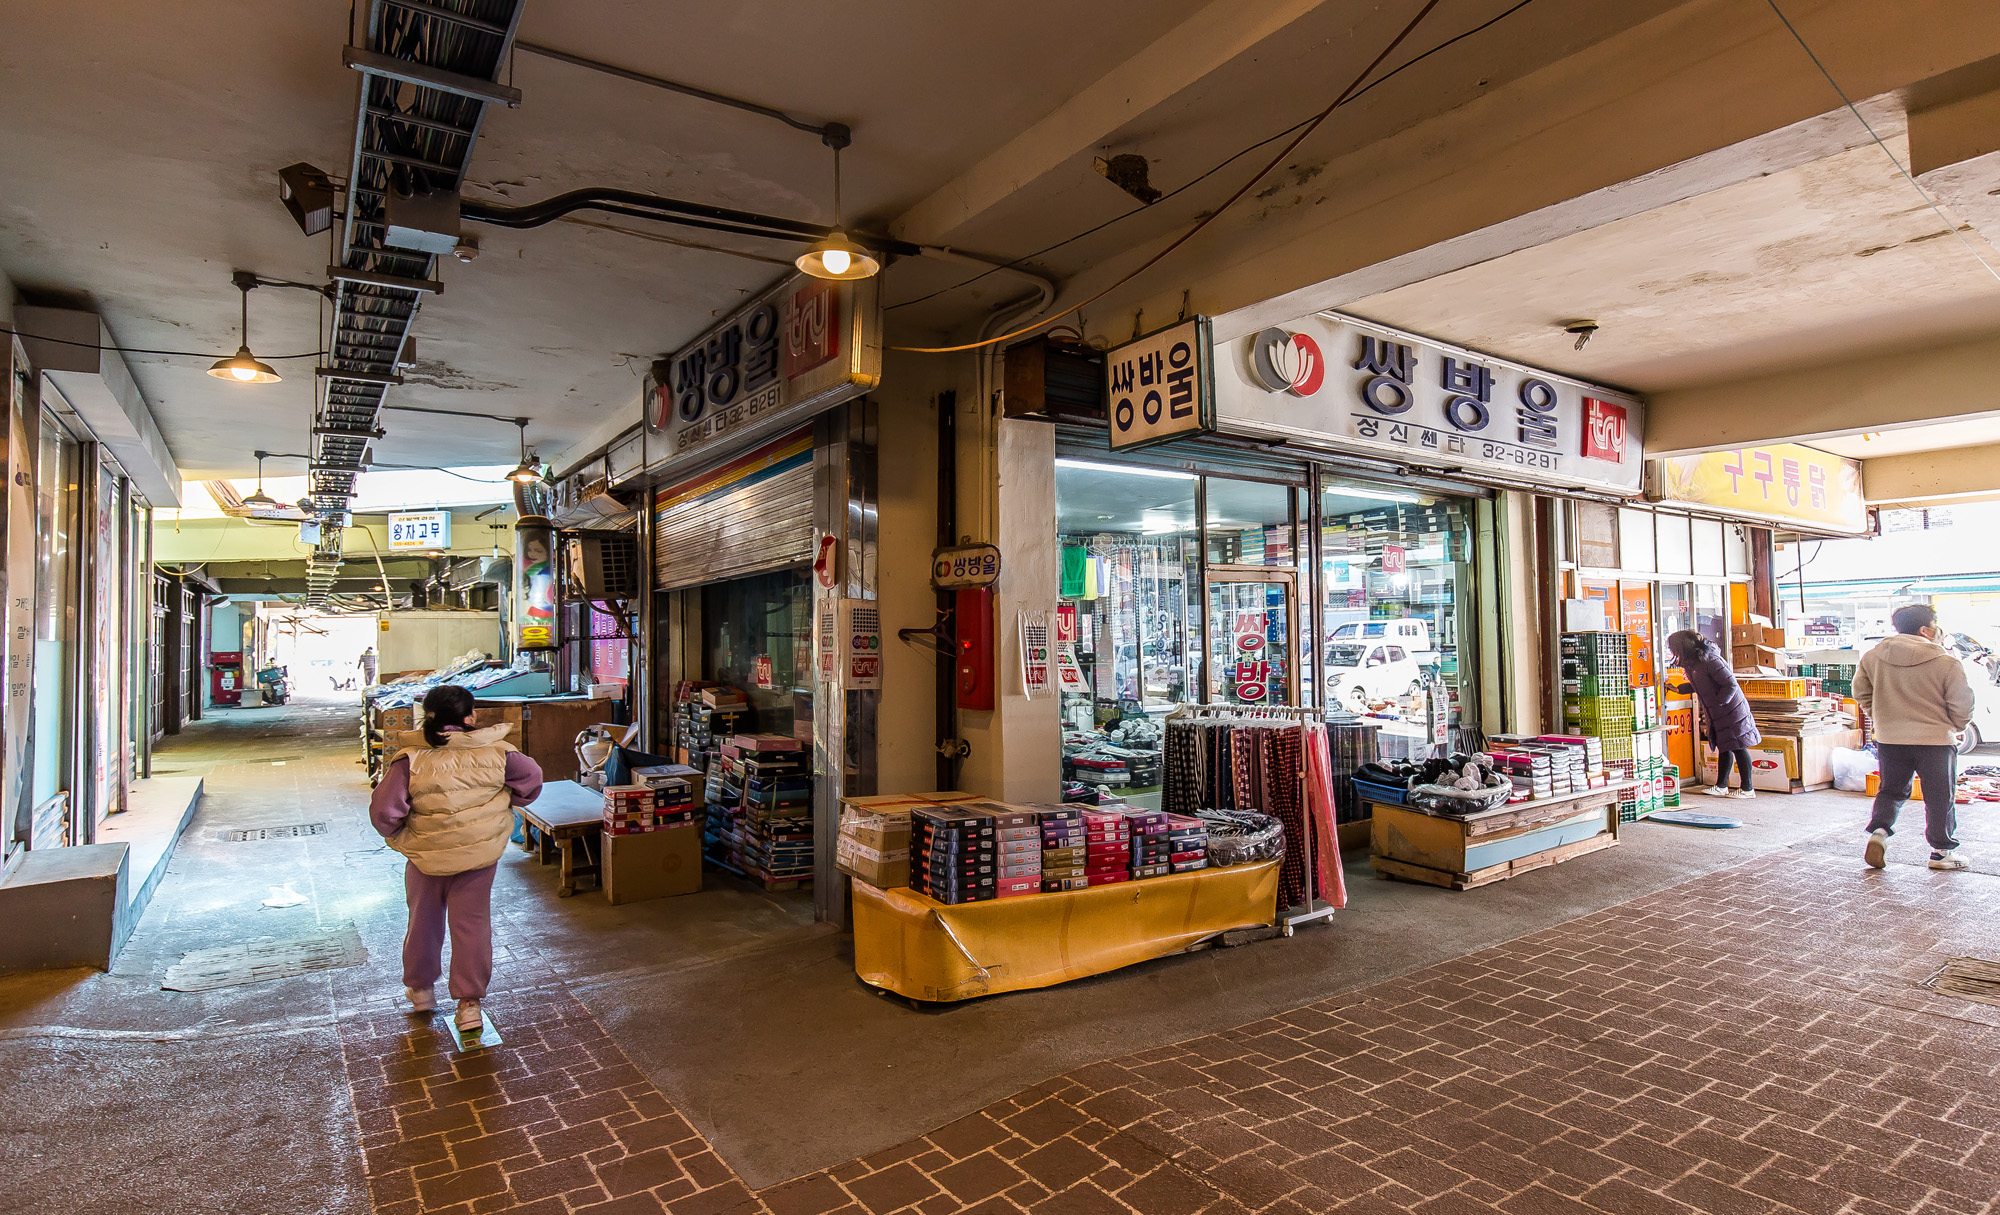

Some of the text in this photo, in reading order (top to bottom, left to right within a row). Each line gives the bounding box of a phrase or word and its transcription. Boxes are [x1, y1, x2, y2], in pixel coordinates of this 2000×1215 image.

[676, 304, 779, 423] 쌍방울
[1111, 342, 1194, 432] 쌍방울
[1354, 335, 1558, 448] 쌍방울
[1482, 443, 1557, 471] 32-6291
[1724, 449, 1826, 510] 구구통닭
[393, 523, 440, 541] 왕자고무
[953, 554, 996, 578] 쌍방울
[1383, 546, 1405, 573] try
